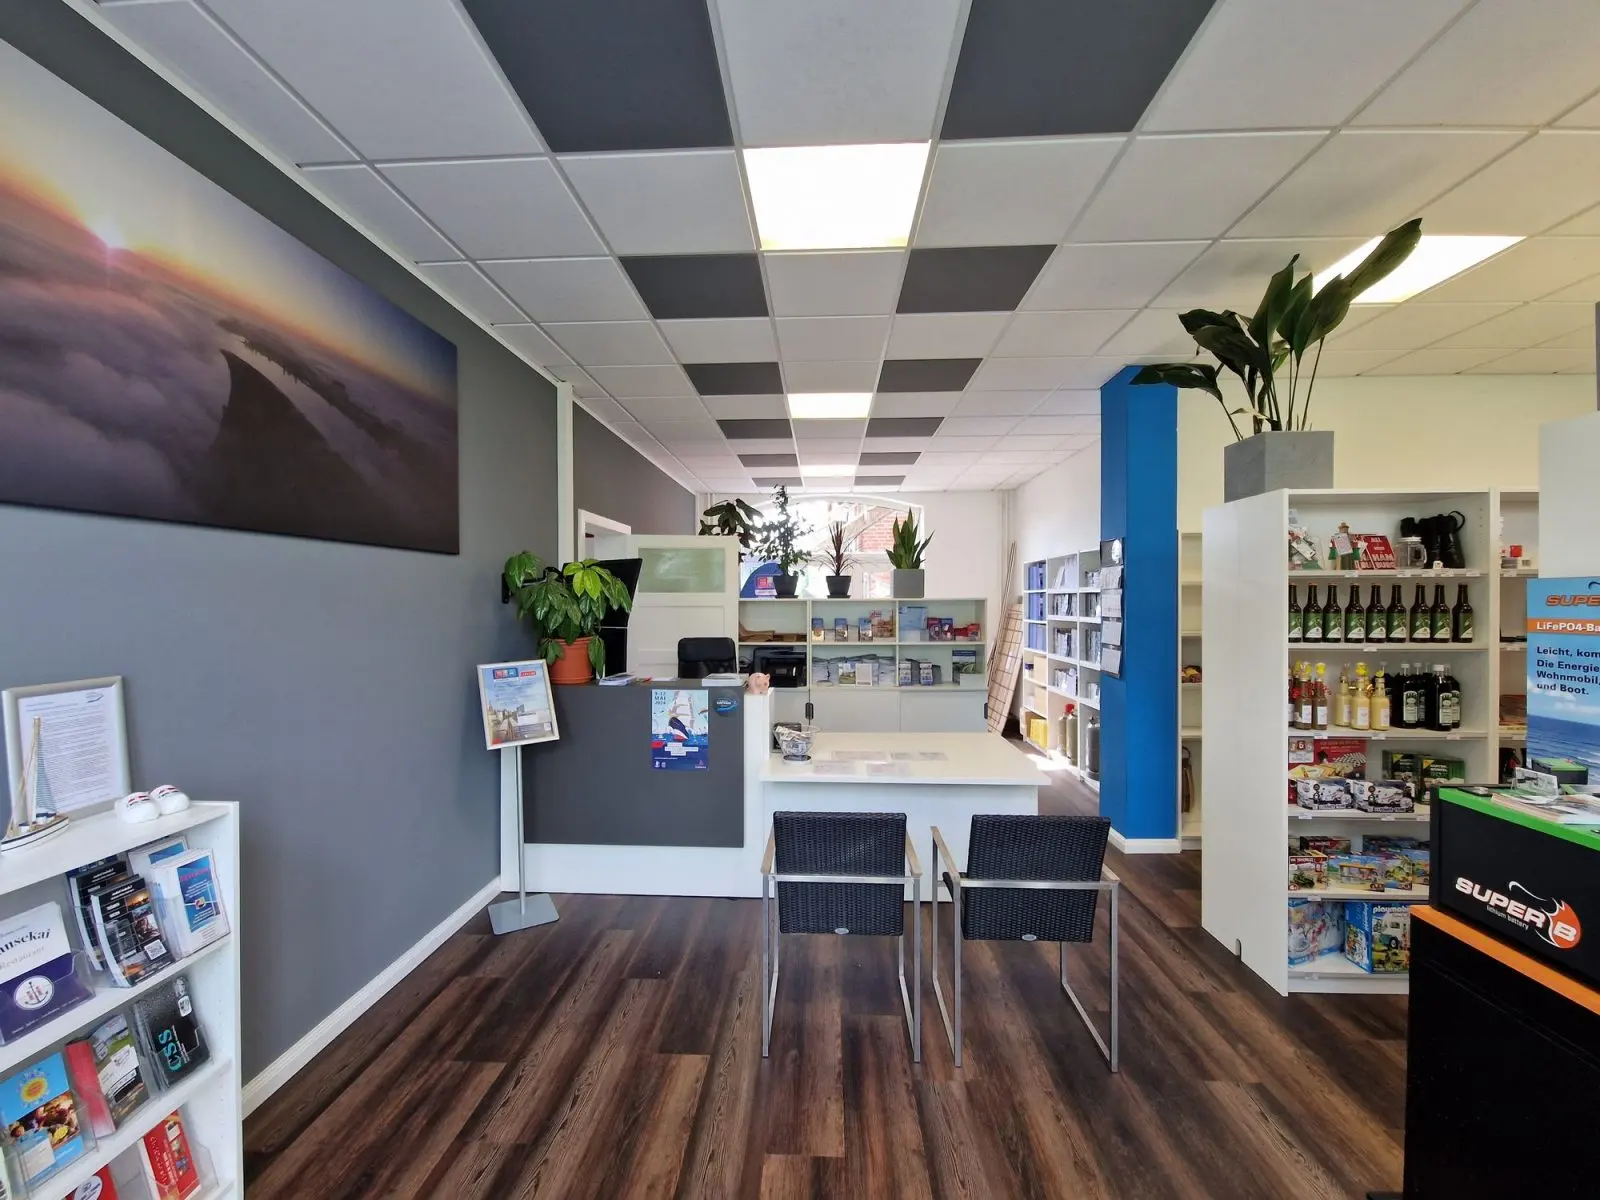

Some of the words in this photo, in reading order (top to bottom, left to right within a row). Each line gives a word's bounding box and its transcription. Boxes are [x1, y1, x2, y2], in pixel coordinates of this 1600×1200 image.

[1546, 594, 1600, 607] SUPE
[1537, 646, 1573, 657] Leicht,
[1537, 659, 1554, 668] Die
[1536, 682, 1557, 692] und
[1560, 683, 1589, 695] Boot.
[1373, 905, 1409, 914] playmobi
[1455, 877, 1546, 928] SUPER
[1553, 921, 1577, 942] B
[1507, 914, 1529, 930] battery
